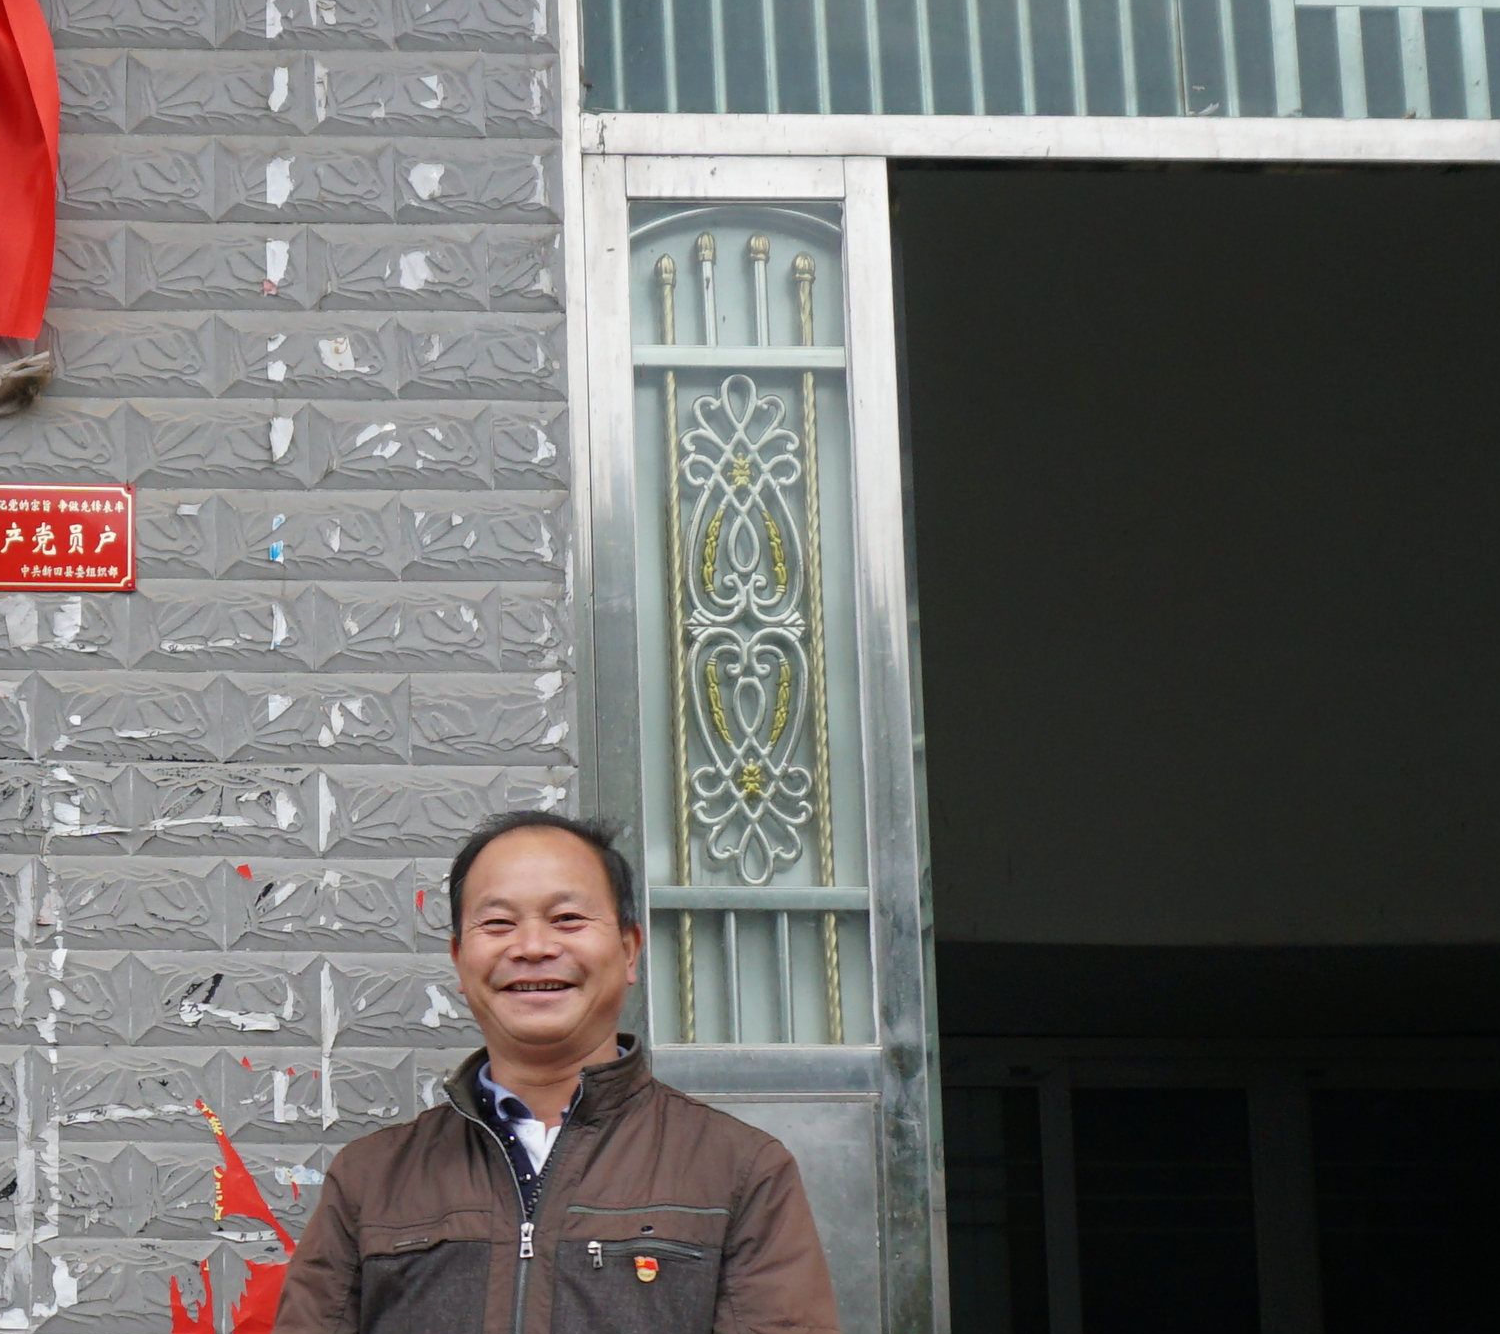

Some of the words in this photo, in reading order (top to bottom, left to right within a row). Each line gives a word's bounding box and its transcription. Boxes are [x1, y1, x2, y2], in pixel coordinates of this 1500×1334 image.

[57, 499, 125, 514] 争做先锋表率
[20, 564, 119, 579] 中共新田县委组织部
